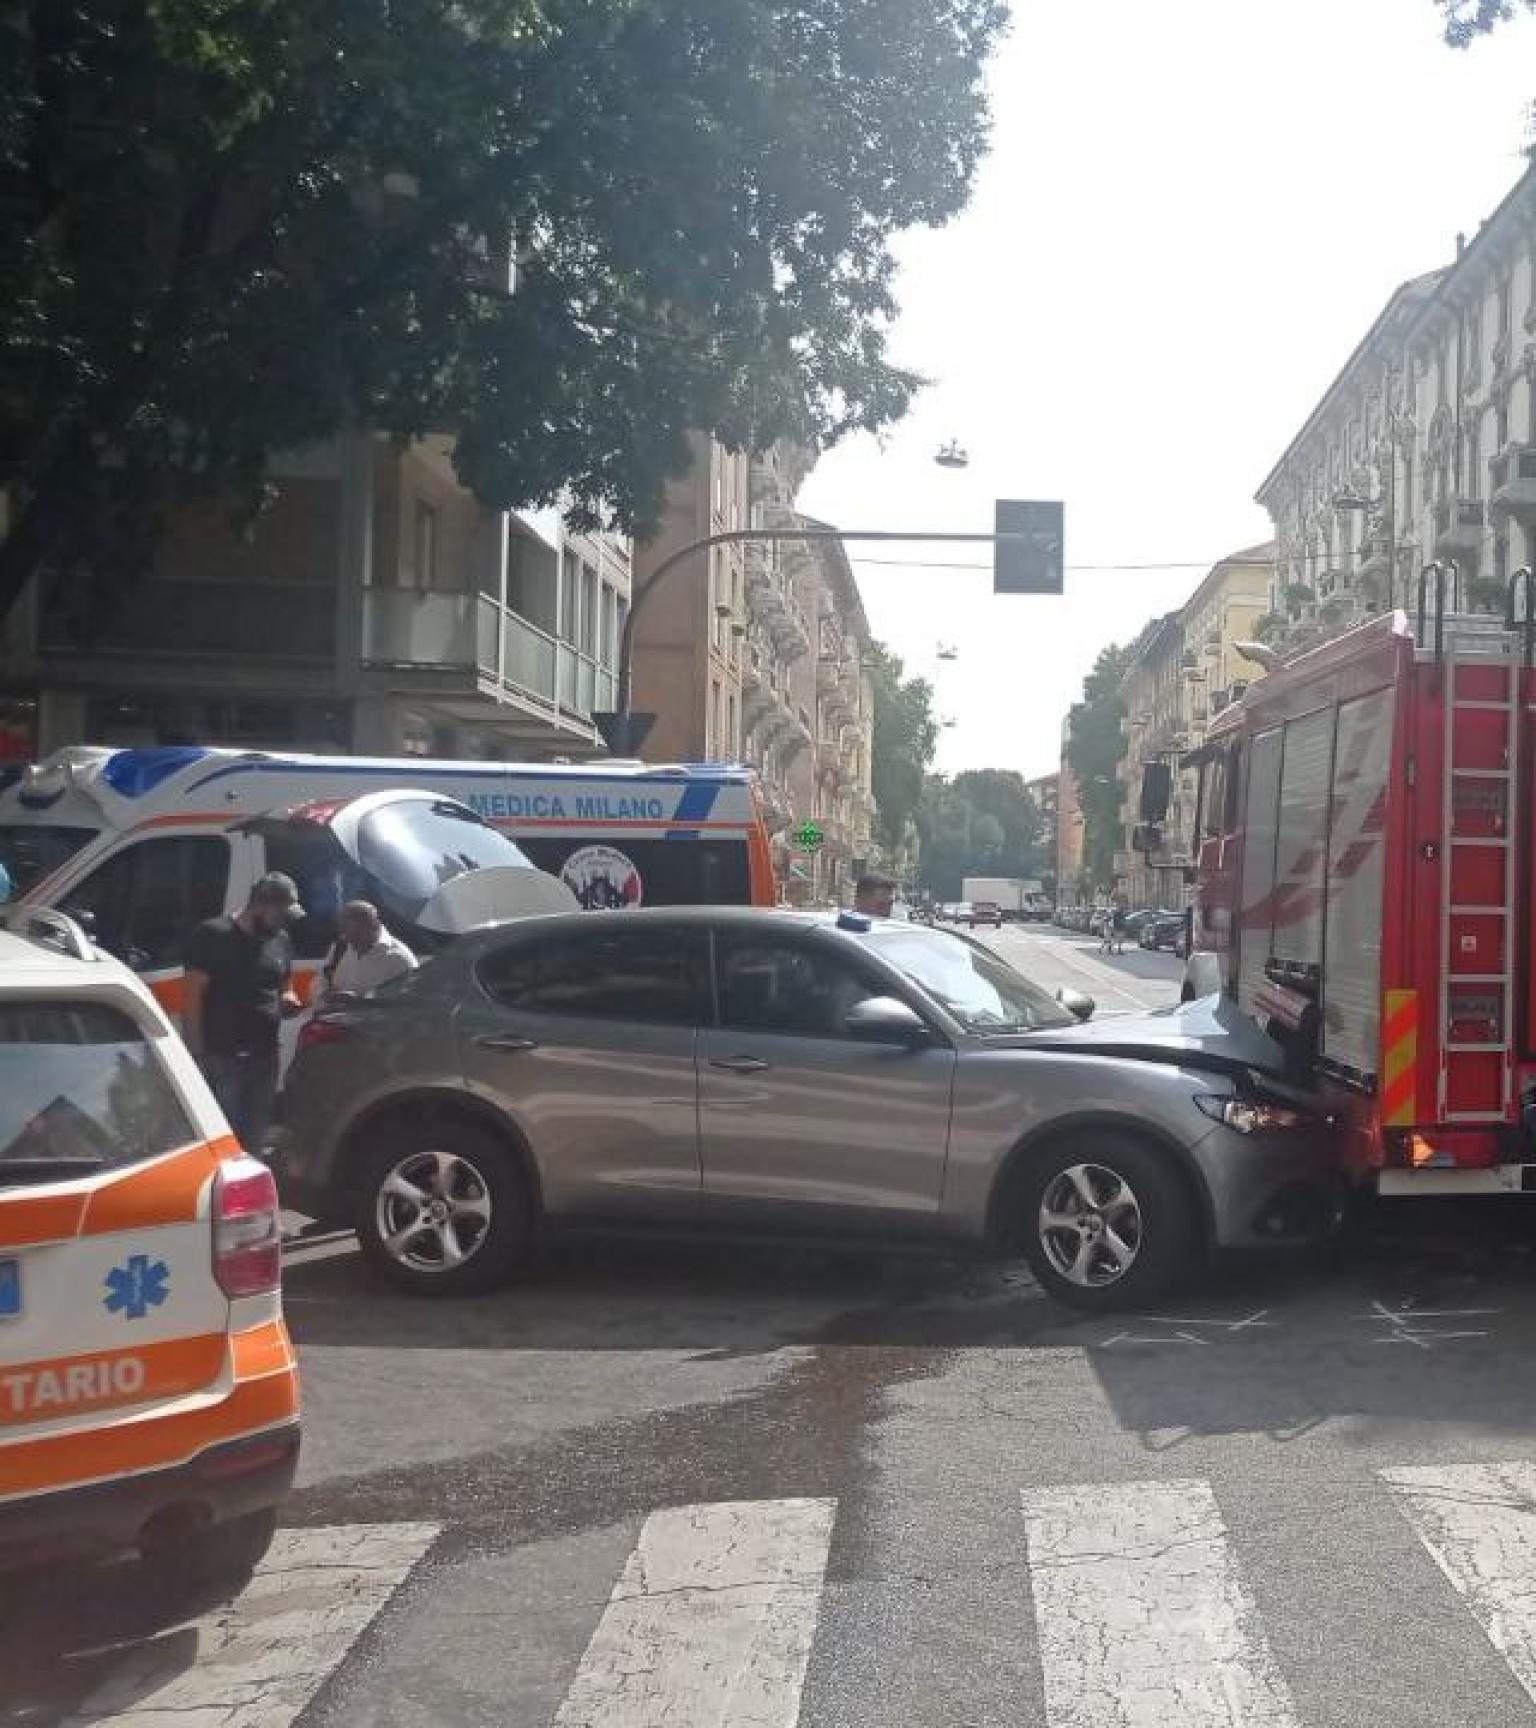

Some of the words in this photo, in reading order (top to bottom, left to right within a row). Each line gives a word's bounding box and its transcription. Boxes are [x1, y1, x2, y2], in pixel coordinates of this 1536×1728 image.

[469, 792, 566, 818] MEDICA
[575, 794, 663, 819] MILANO
[2, 1356, 145, 1412] TARIO
